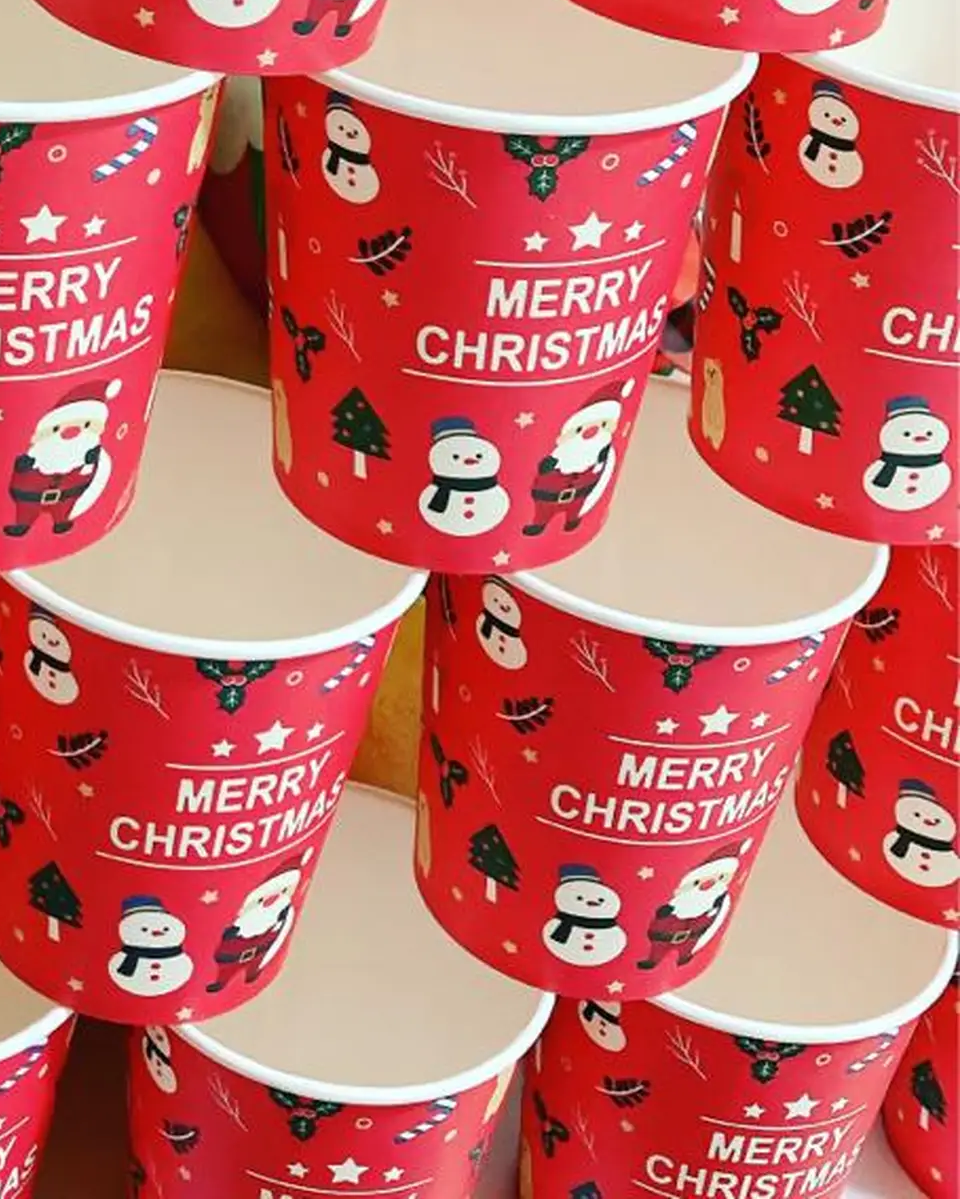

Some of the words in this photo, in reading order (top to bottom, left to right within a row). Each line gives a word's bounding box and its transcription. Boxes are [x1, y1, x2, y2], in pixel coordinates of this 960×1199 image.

[486, 259, 653, 319] MERRY
[416, 295, 668, 372] CHRISTMAS
[175, 750, 331, 813] MERRY
[617, 742, 776, 790] MERRY
[109, 771, 345, 858] CHRISTMAS
[550, 765, 789, 834] CHRISTMAS
[645, 1136, 866, 1199] CHRISTMAS
[707, 1117, 856, 1165] MERRY
